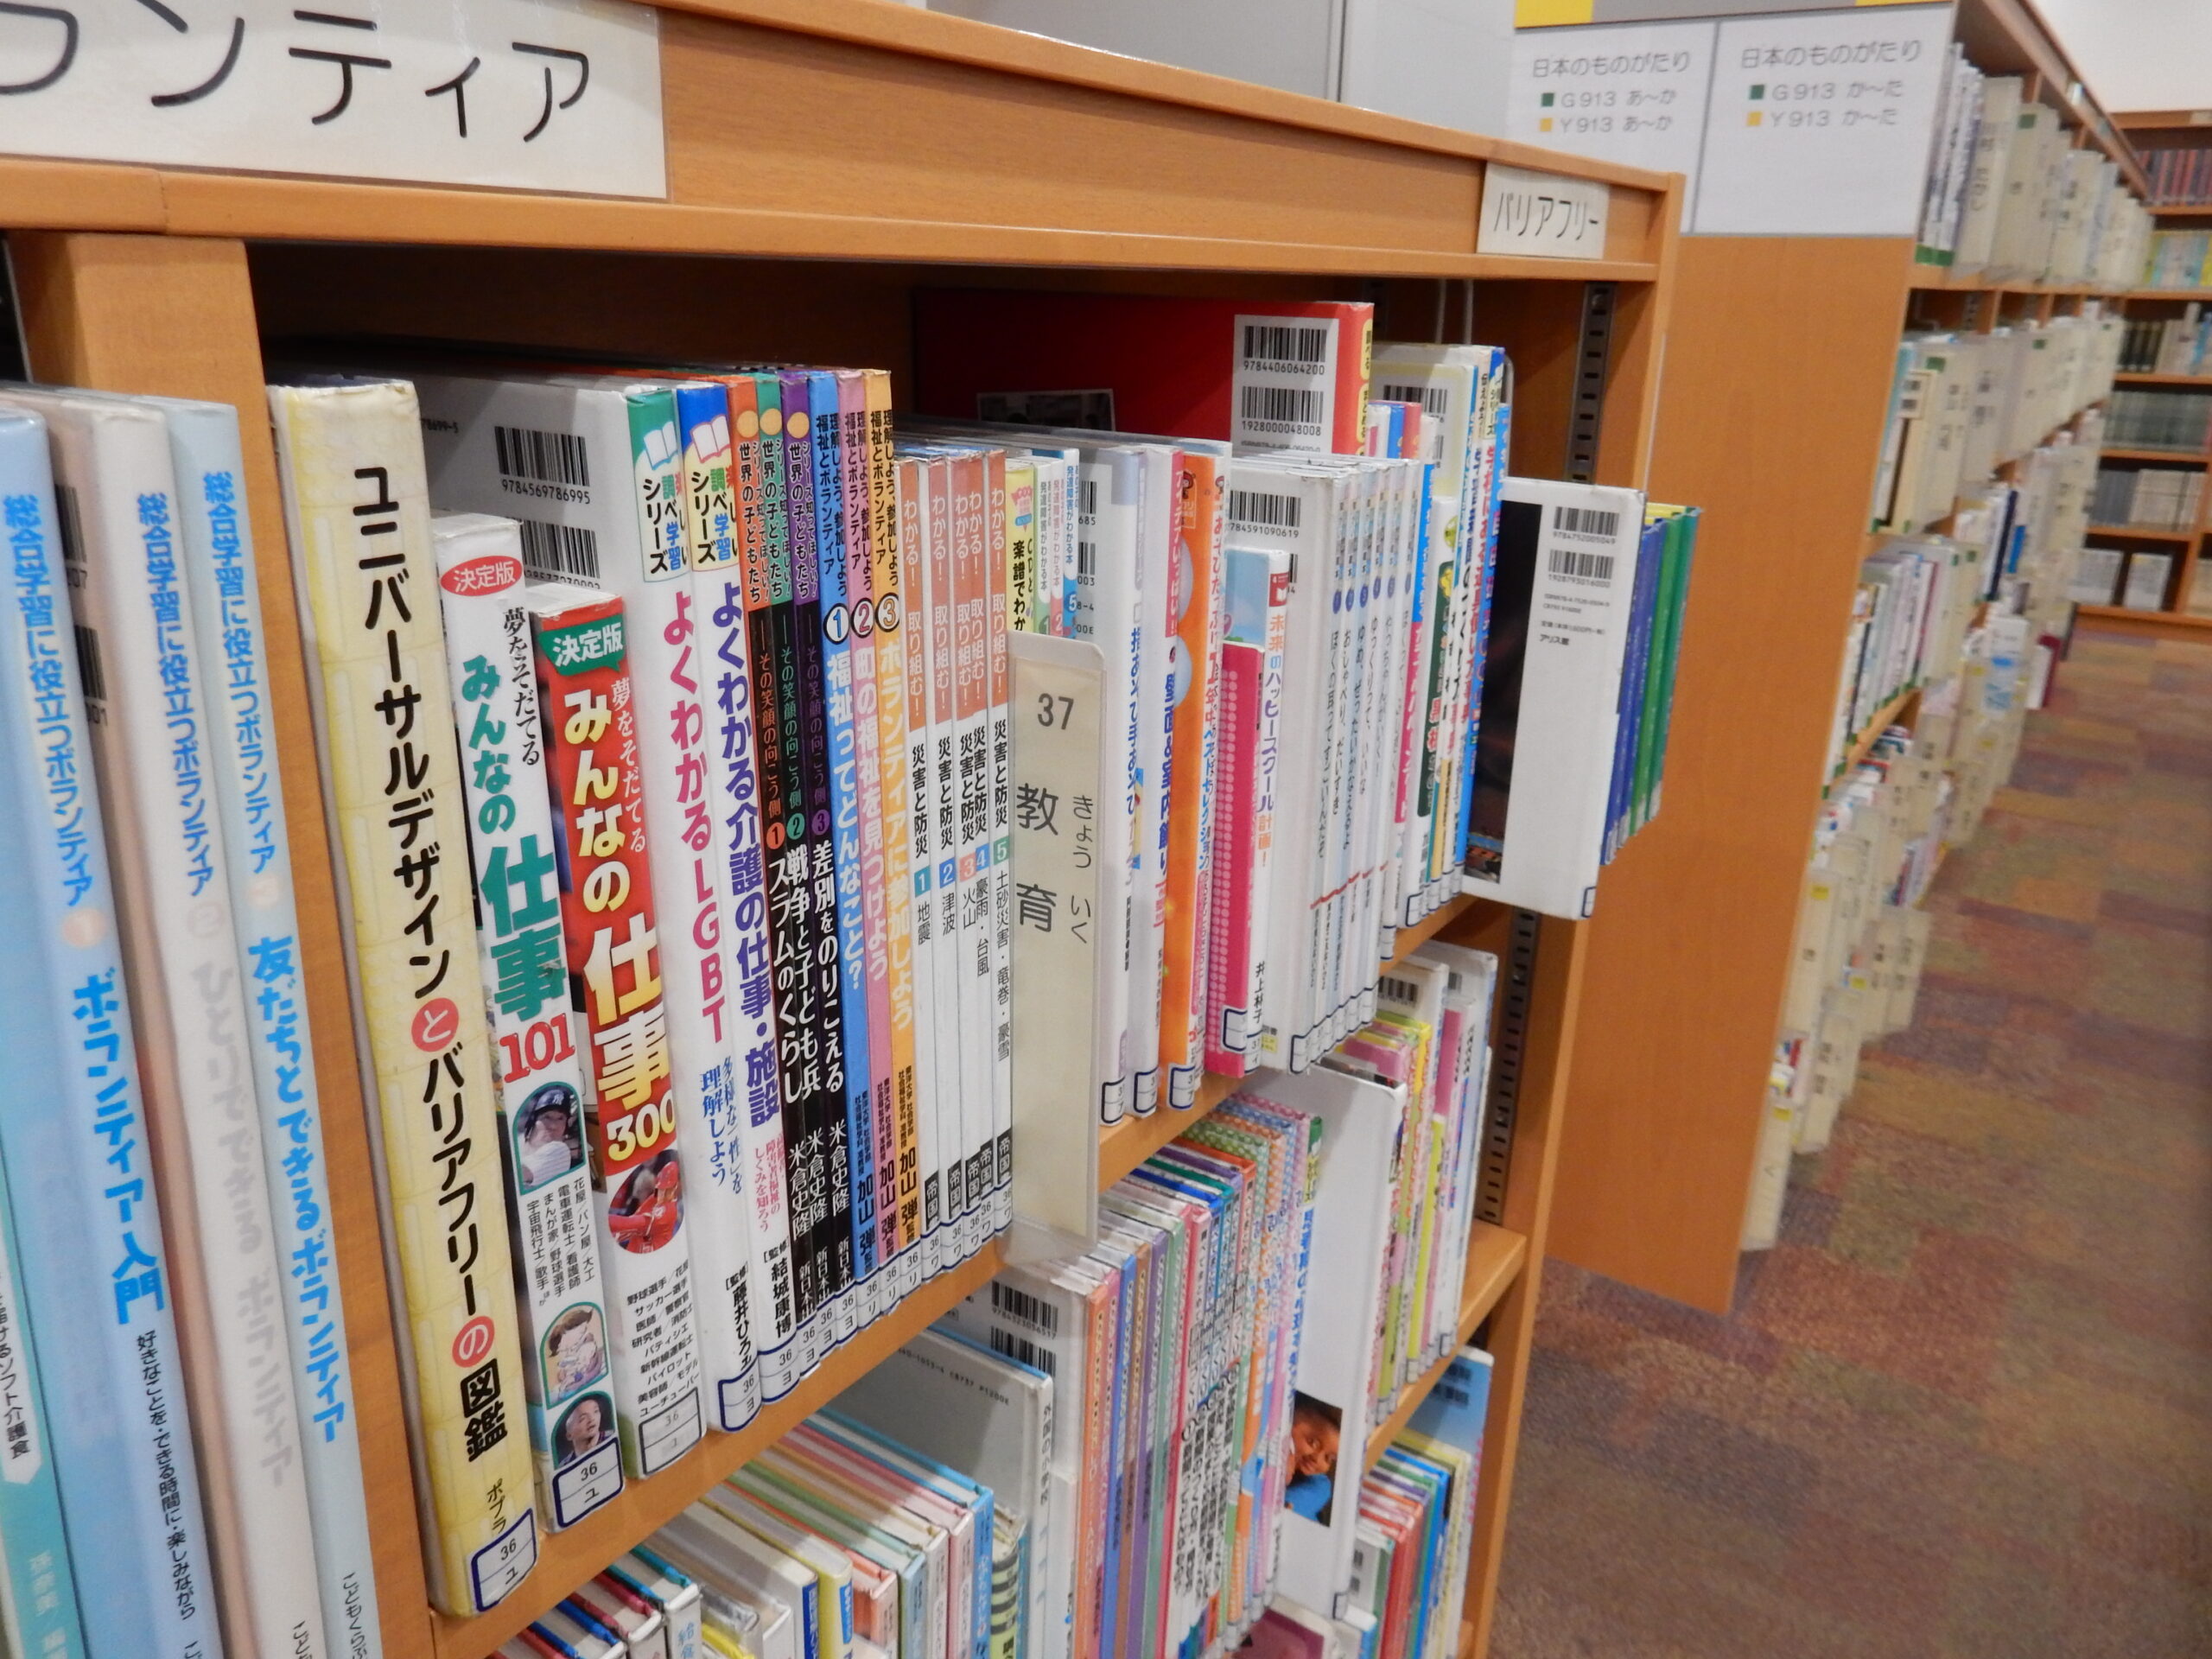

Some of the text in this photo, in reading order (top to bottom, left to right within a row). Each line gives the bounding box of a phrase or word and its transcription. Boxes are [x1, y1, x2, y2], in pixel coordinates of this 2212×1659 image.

[1533, 51, 1690, 78] 日本のものがたり
[1741, 40, 1921, 69] 日本のものがたり
[1494, 192, 1598, 240] バリアフリー
[1243, 360, 1325, 375] 9784406064200
[1242, 420, 1321, 435] 1928000048008
[502, 478, 591, 505] 9784569786995
[642, 478, 669, 575] シリーズ
[691, 471, 716, 563] シリーズ
[709, 467, 732, 562] 調べ学習
[739, 444, 761, 604] 世界の子どもたち
[761, 441, 783, 598] 世界の子どもたち
[788, 443, 810, 599] 世界の子どもたち
[816, 413, 835, 575] 福祉とボランティア
[845, 412, 861, 570] 福祉とボランティア
[870, 410, 886, 566] 福祉とボランティア
[454, 561, 516, 592] 決定版
[1013, 540, 1026, 631] 楽譜でわか
[202, 471, 276, 874] 総合学習に役立つボランティア
[503, 606, 540, 766] 夢をそだてる
[553, 621, 624, 667] 決定版
[907, 611, 924, 717] 取り組む!
[934, 605, 949, 709] 取り組む!
[957, 603, 972, 707] 取り組む!
[970, 597, 985, 699] 取り組む!
[992, 594, 1007, 695] 取り組む!
[3, 493, 93, 906] 総合学習に役立つボランティア
[136, 493, 213, 897] 総合学習に役立つボランティア
[1037, 693, 1074, 730] 37
[611, 677, 646, 854] 夢をそだてる
[912, 743, 928, 859] 災害と防災
[938, 735, 953, 850] 災害と防災
[959, 732, 975, 845] 災害と防災
[973, 725, 987, 836] 災害と防災
[994, 719, 1008, 829] 災害と防災
[462, 654, 567, 1022] みんなの仕事
[664, 591, 726, 1044] よくわかるLGBT
[713, 582, 780, 1128] よくわかる介護の仕事・施設
[827, 652, 865, 990] 福祉ってどんなこと?
[1016, 783, 1058, 932] 教育
[942, 893, 956, 936] 津波
[963, 887, 976, 931] 火山
[1071, 795, 1093, 944] きょういく
[353, 466, 508, 1462] ユニバーサルデザインとバリアフリーの図鑑
[563, 689, 677, 1163] みんなの仕事 300
[786, 843, 820, 1101] 戦争と子ども兵
[811, 839, 844, 1094] 差別をのりこえる
[918, 900, 931, 946] 地震
[768, 858, 800, 1104] スラムのくらし
[499, 1013, 576, 1084] 101
[73, 966, 165, 1325] ボランティア入門
[701, 1065, 726, 1187] 理解しよう
[829, 1120, 850, 1217] 米倉史隆
[900, 1147, 917, 1197] 加山
[248, 936, 345, 1443] 友だちとできるボランティア
[788, 1141, 810, 1242] 米倉史隆
[807, 1128, 829, 1226] 米倉史隆
[857, 1173, 874, 1224] 加山
[880, 1159, 896, 1211] 加山
[969, 1214, 980, 1230] 36
[981, 1200, 991, 1216] 36
[887, 1266, 897, 1282] 36
[907, 1250, 918, 1268] 36
[930, 1236, 939, 1251] 36
[952, 1224, 962, 1239] 36
[803, 1326, 816, 1344] 36
[821, 1306, 833, 1325] 36
[842, 1294, 854, 1311] 36
[867, 1280, 878, 1296] 36
[743, 1373, 754, 1394] 36
[779, 1349, 792, 1367] 36
[580, 1462, 598, 1482] 36
[500, 1538, 518, 1560] 36
